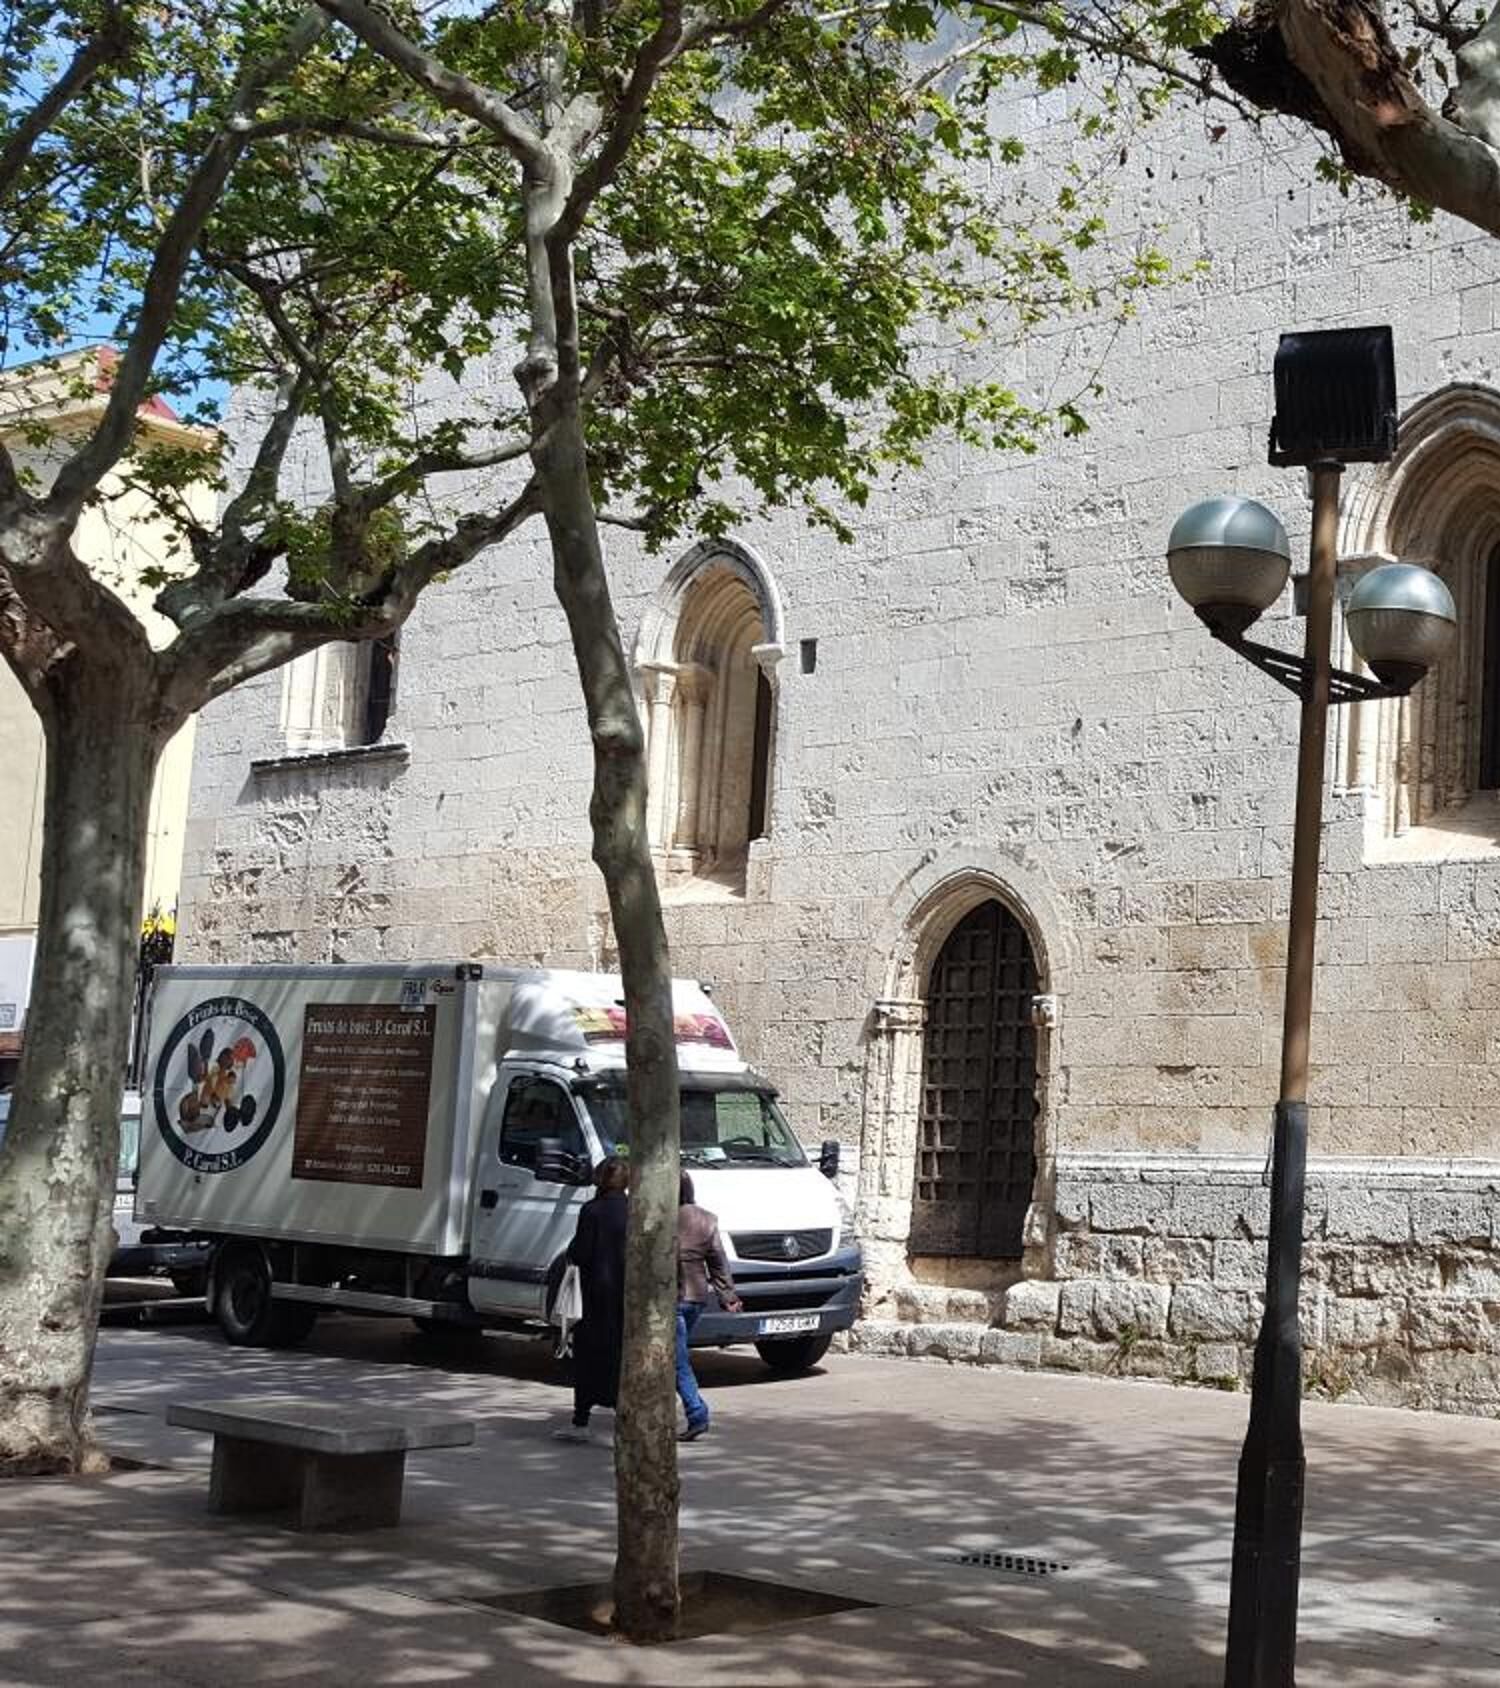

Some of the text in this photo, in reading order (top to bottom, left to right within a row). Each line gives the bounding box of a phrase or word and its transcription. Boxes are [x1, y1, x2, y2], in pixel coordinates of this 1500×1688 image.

[188, 1003, 219, 1028] Fruits
[307, 1017, 334, 1034] Fruits
[336, 1018, 348, 1034] de
